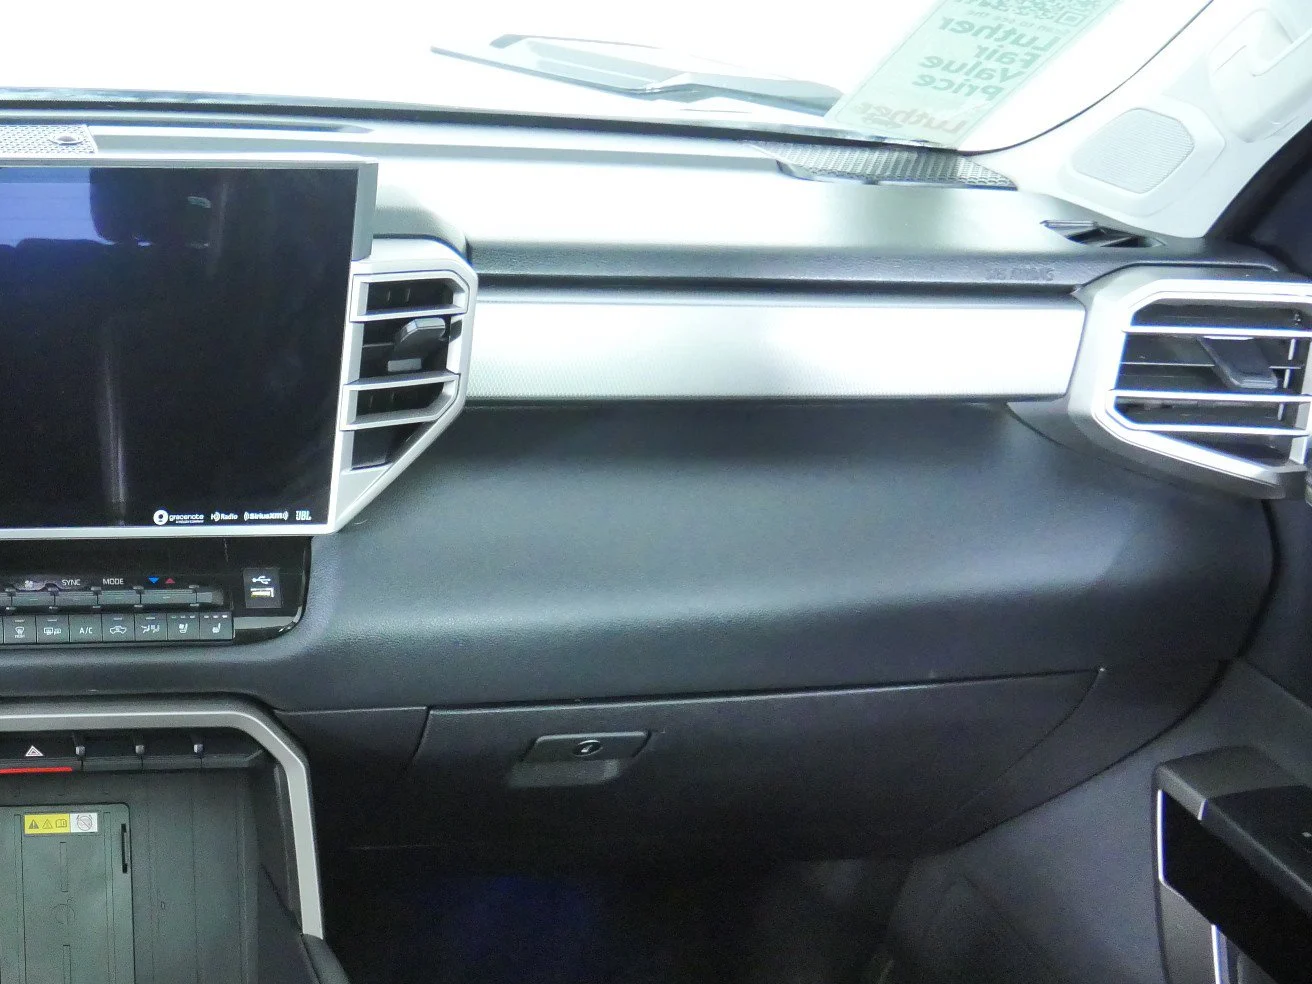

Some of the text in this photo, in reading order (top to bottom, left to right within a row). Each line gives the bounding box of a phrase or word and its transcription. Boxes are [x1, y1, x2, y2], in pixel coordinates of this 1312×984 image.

[296, 510, 312, 521] JBL
[61, 578, 81, 587] SYNC
[102, 577, 125, 586] MODE
[79, 626, 93, 635] A/C
